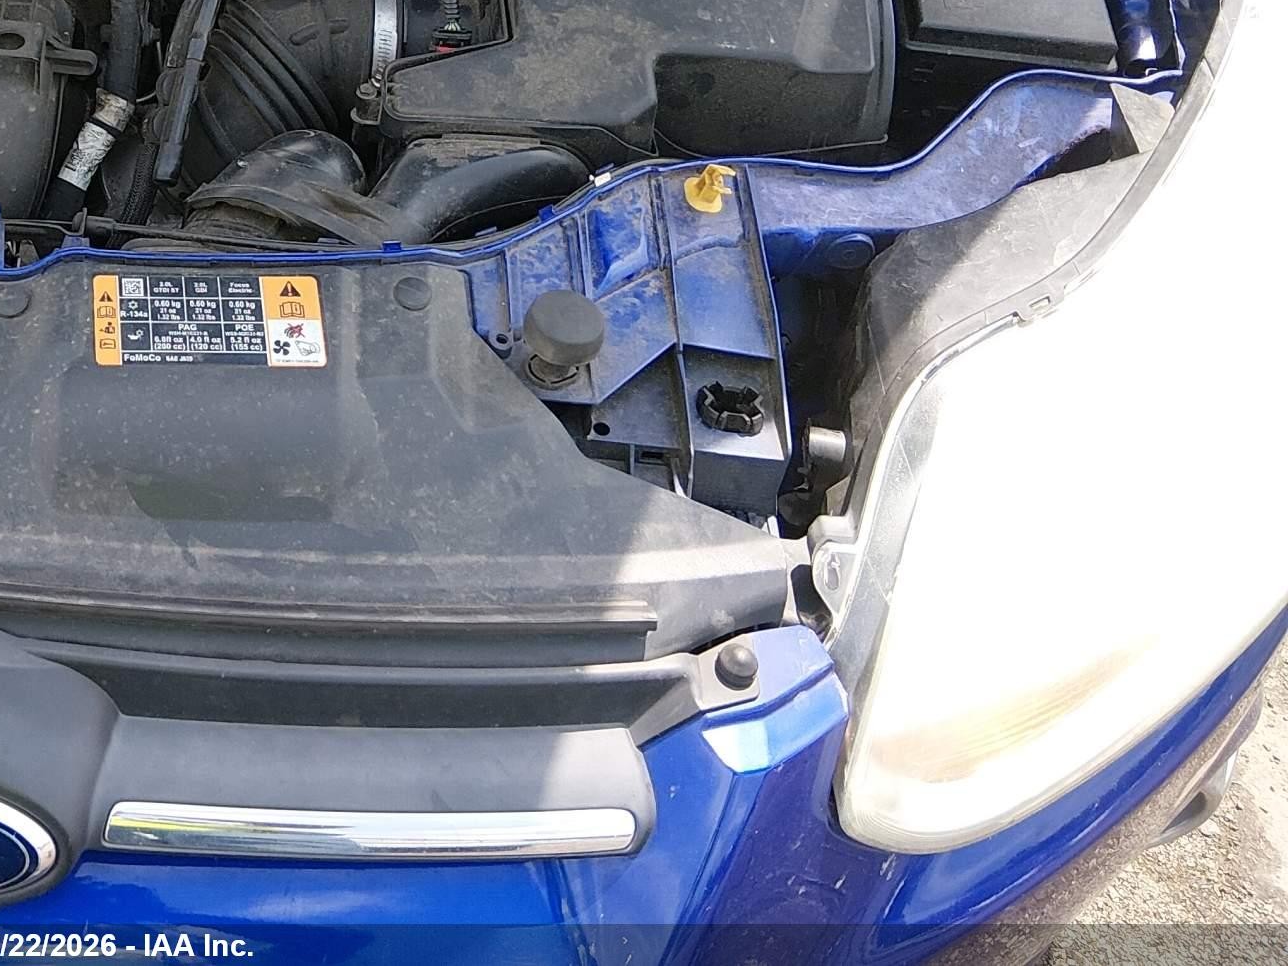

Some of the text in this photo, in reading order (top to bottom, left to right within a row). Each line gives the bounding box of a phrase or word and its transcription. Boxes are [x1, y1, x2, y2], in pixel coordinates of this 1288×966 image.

[171, 300, 181, 309] kg
[189, 300, 216, 309] 0.60 kg
[229, 300, 256, 309] 0.60 kg
[120, 310, 148, 318] R-134a
[173, 343, 186, 351] cc)
[190, 343, 223, 351] (120 cc)
[250, 344, 263, 352] cc)
[123, 353, 161, 362] FoMoCo
